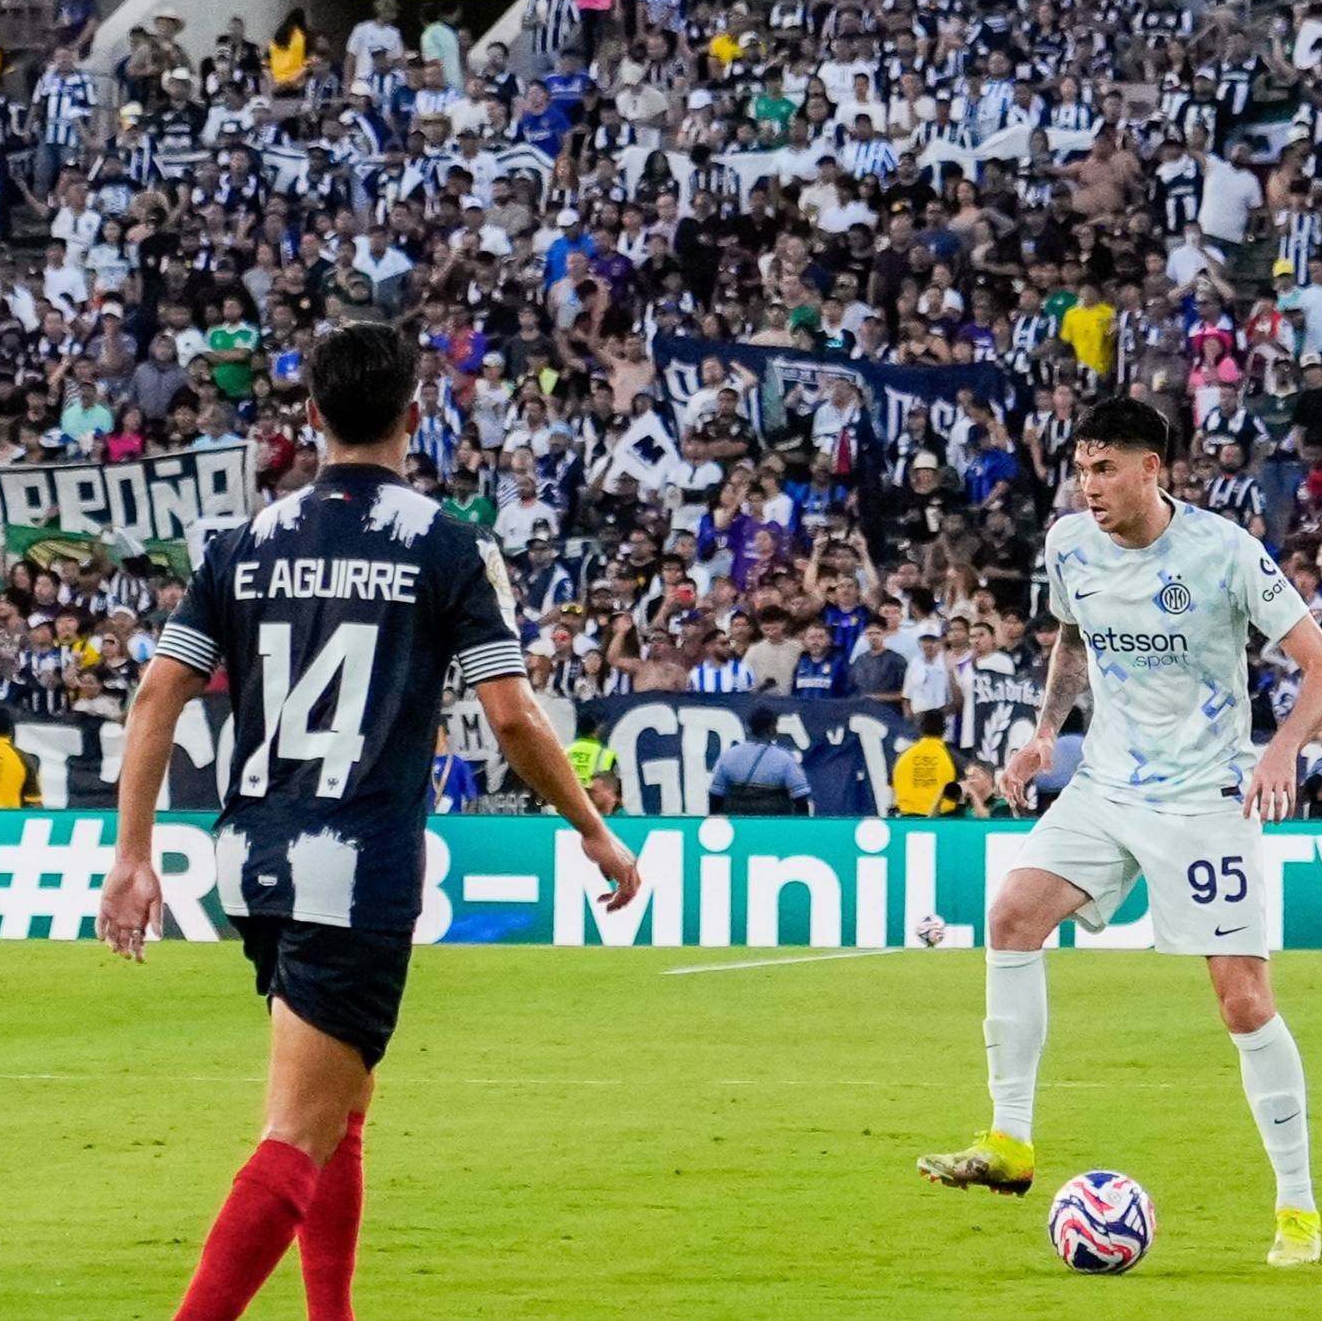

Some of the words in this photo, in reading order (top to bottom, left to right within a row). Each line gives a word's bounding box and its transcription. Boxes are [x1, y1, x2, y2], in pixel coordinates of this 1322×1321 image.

[268, 558, 420, 604] AGUIRRE
[240, 623, 379, 799] 14
[1186, 855, 1248, 905] 95
